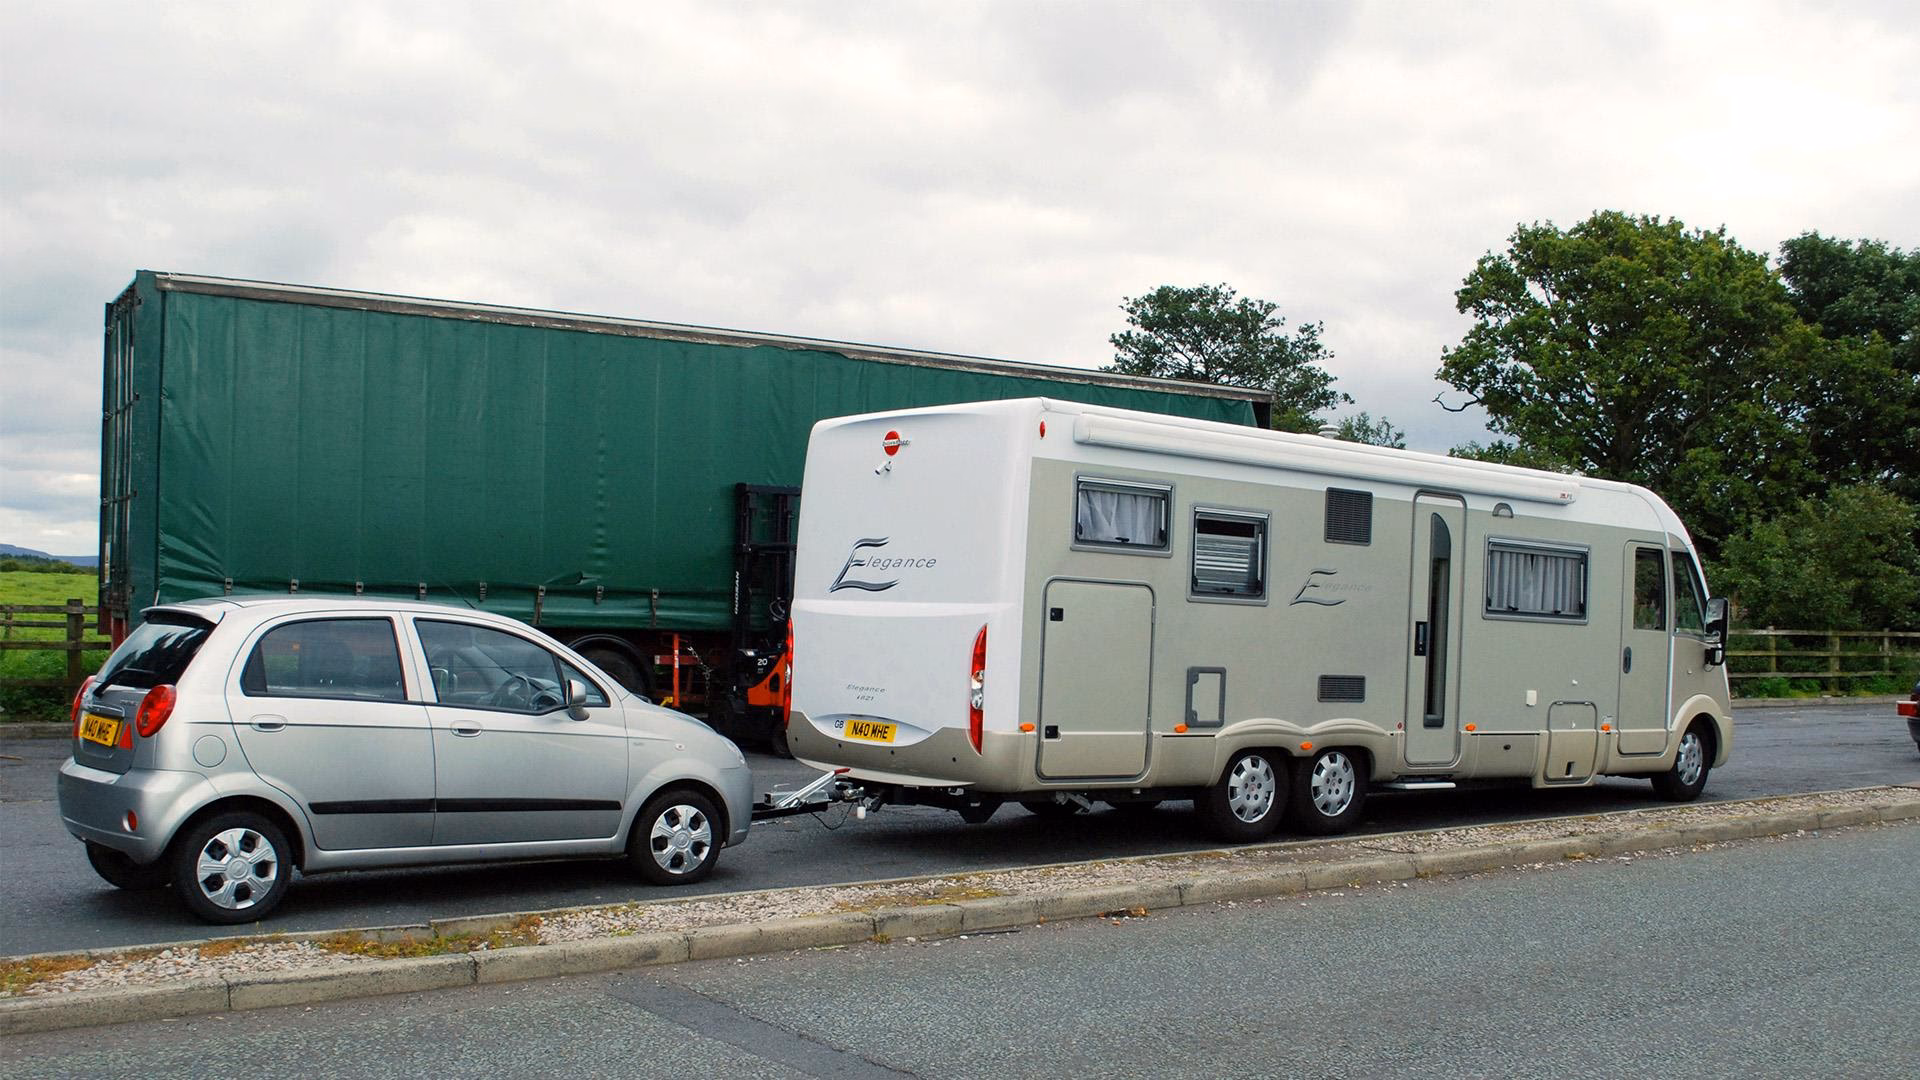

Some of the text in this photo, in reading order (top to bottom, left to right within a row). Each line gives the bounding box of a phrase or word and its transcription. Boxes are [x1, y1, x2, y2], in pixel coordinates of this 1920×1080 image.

[829, 536, 937, 592] Elegance
[757, 658, 768, 666] 20
[834, 719, 844, 729] GB
[870, 724, 890, 740] MHE
